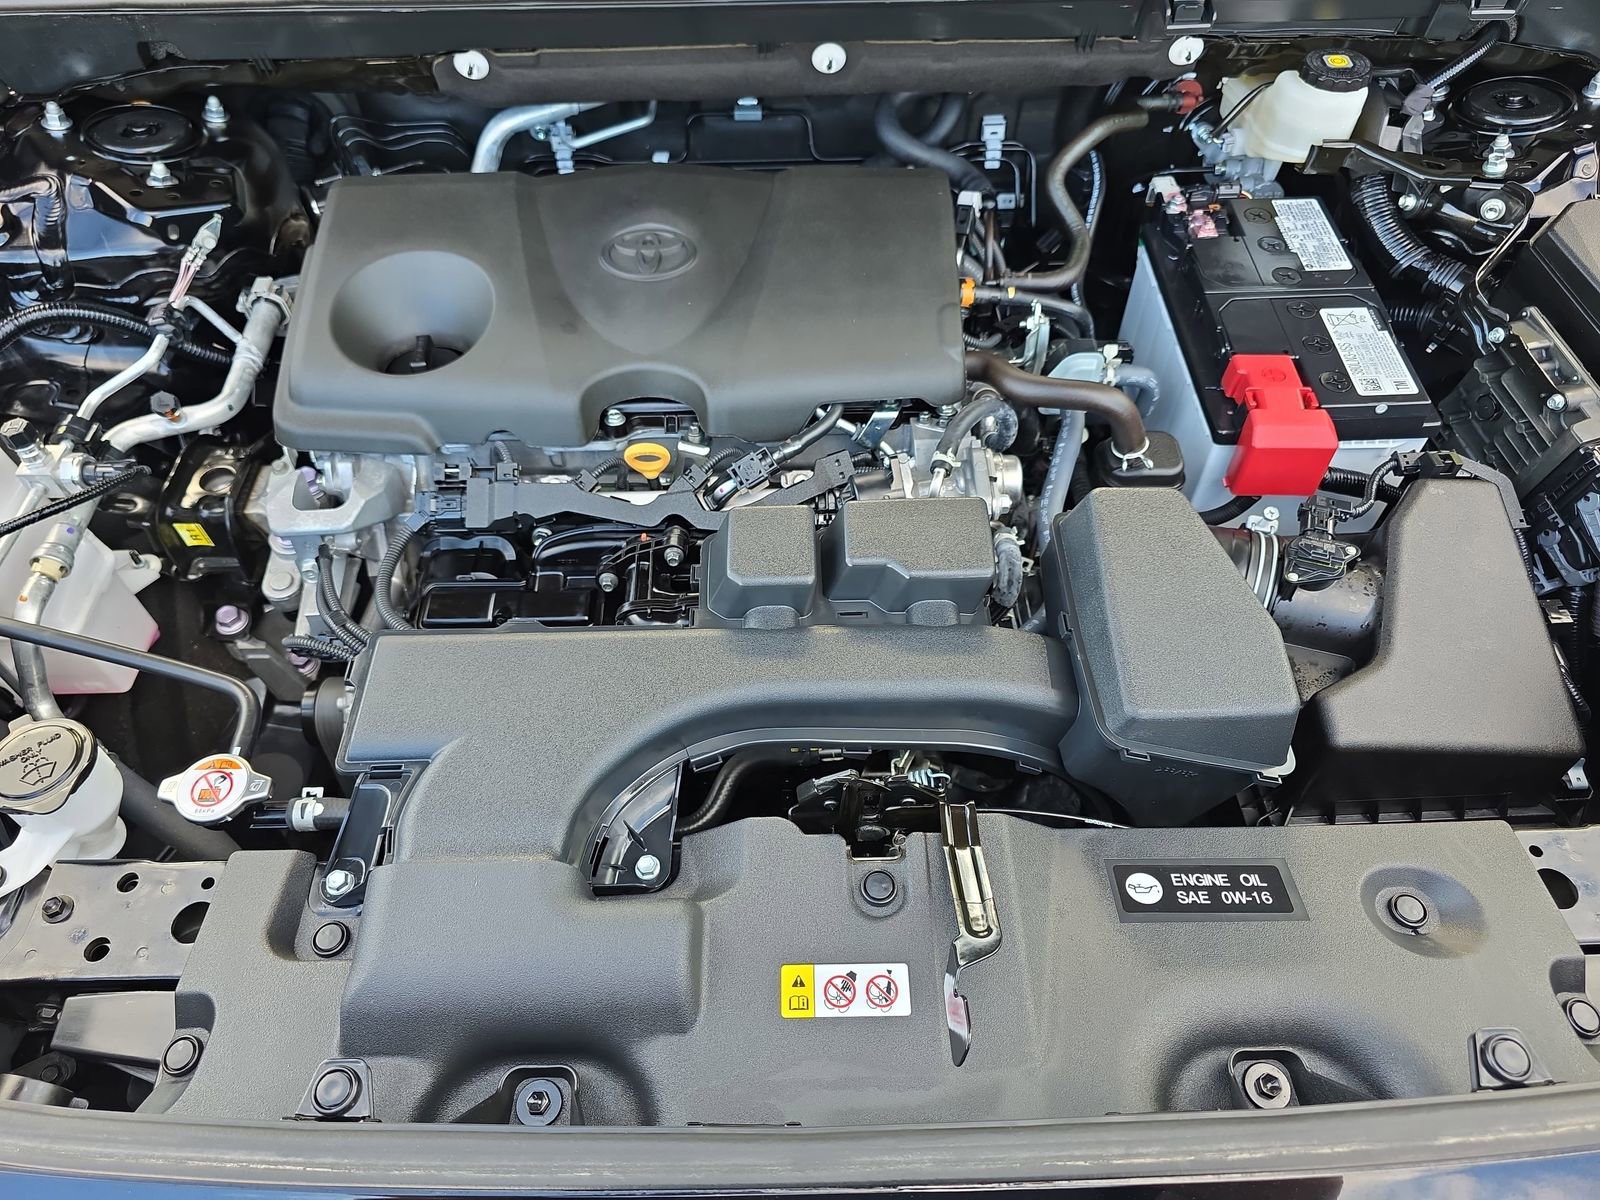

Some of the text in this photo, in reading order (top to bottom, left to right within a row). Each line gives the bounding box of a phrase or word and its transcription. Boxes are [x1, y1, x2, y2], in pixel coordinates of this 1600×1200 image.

[37, 732, 62, 748] FLUID
[20, 747, 42, 763] ONLY
[1170, 873, 1268, 887] ENGINE OIL
[1177, 890, 1273, 905] SAE 0W-16
